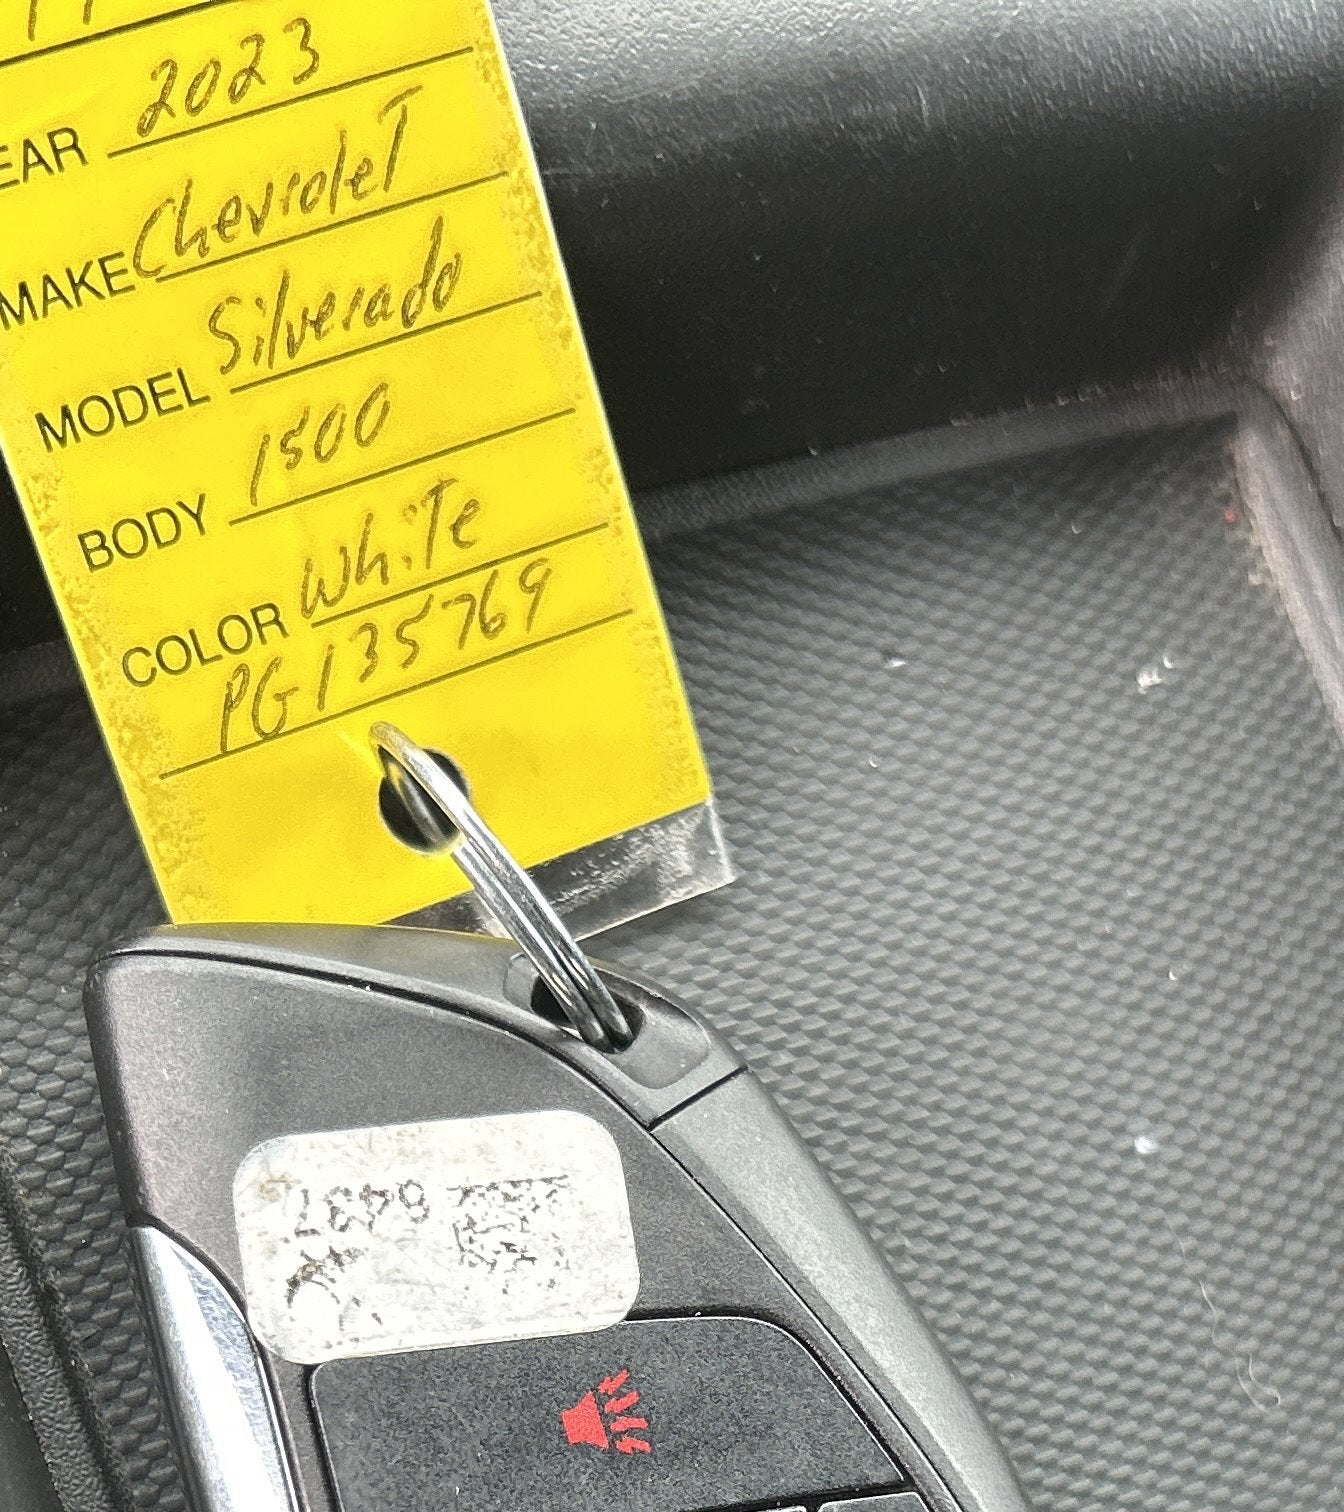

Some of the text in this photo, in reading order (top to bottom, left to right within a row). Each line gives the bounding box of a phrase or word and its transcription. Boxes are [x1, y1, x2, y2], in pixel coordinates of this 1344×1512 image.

[136, 17, 322, 138] 2023
[209, 216, 462, 377] Silverado
[35, 367, 212, 453] MODEL
[251, 383, 392, 506] 1500
[77, 494, 210, 573] BODY
[121, 602, 289, 688] COLOR
[219, 558, 553, 754] PG135769
